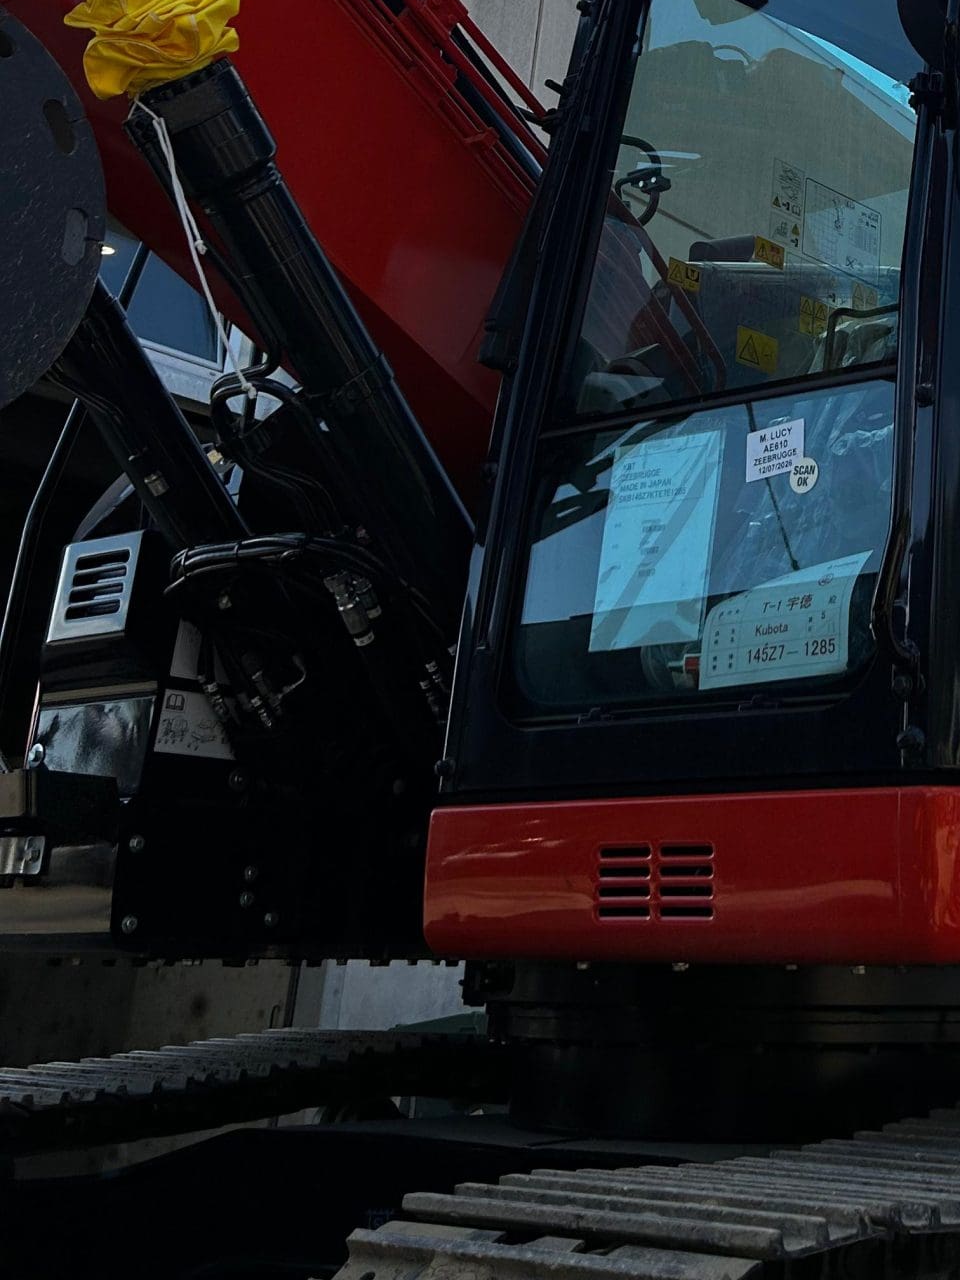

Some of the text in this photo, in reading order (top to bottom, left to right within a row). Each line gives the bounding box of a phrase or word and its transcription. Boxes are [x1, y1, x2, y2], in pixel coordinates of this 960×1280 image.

[760, 427, 792, 443] M. LUCY
[763, 439, 788, 453] AE610
[753, 448, 797, 466] ZEEBRUGGE
[793, 465, 816, 476] SCAN
[648, 478, 672, 488] JAPAN
[797, 477, 809, 487] OK
[755, 624, 789, 637] Kubota
